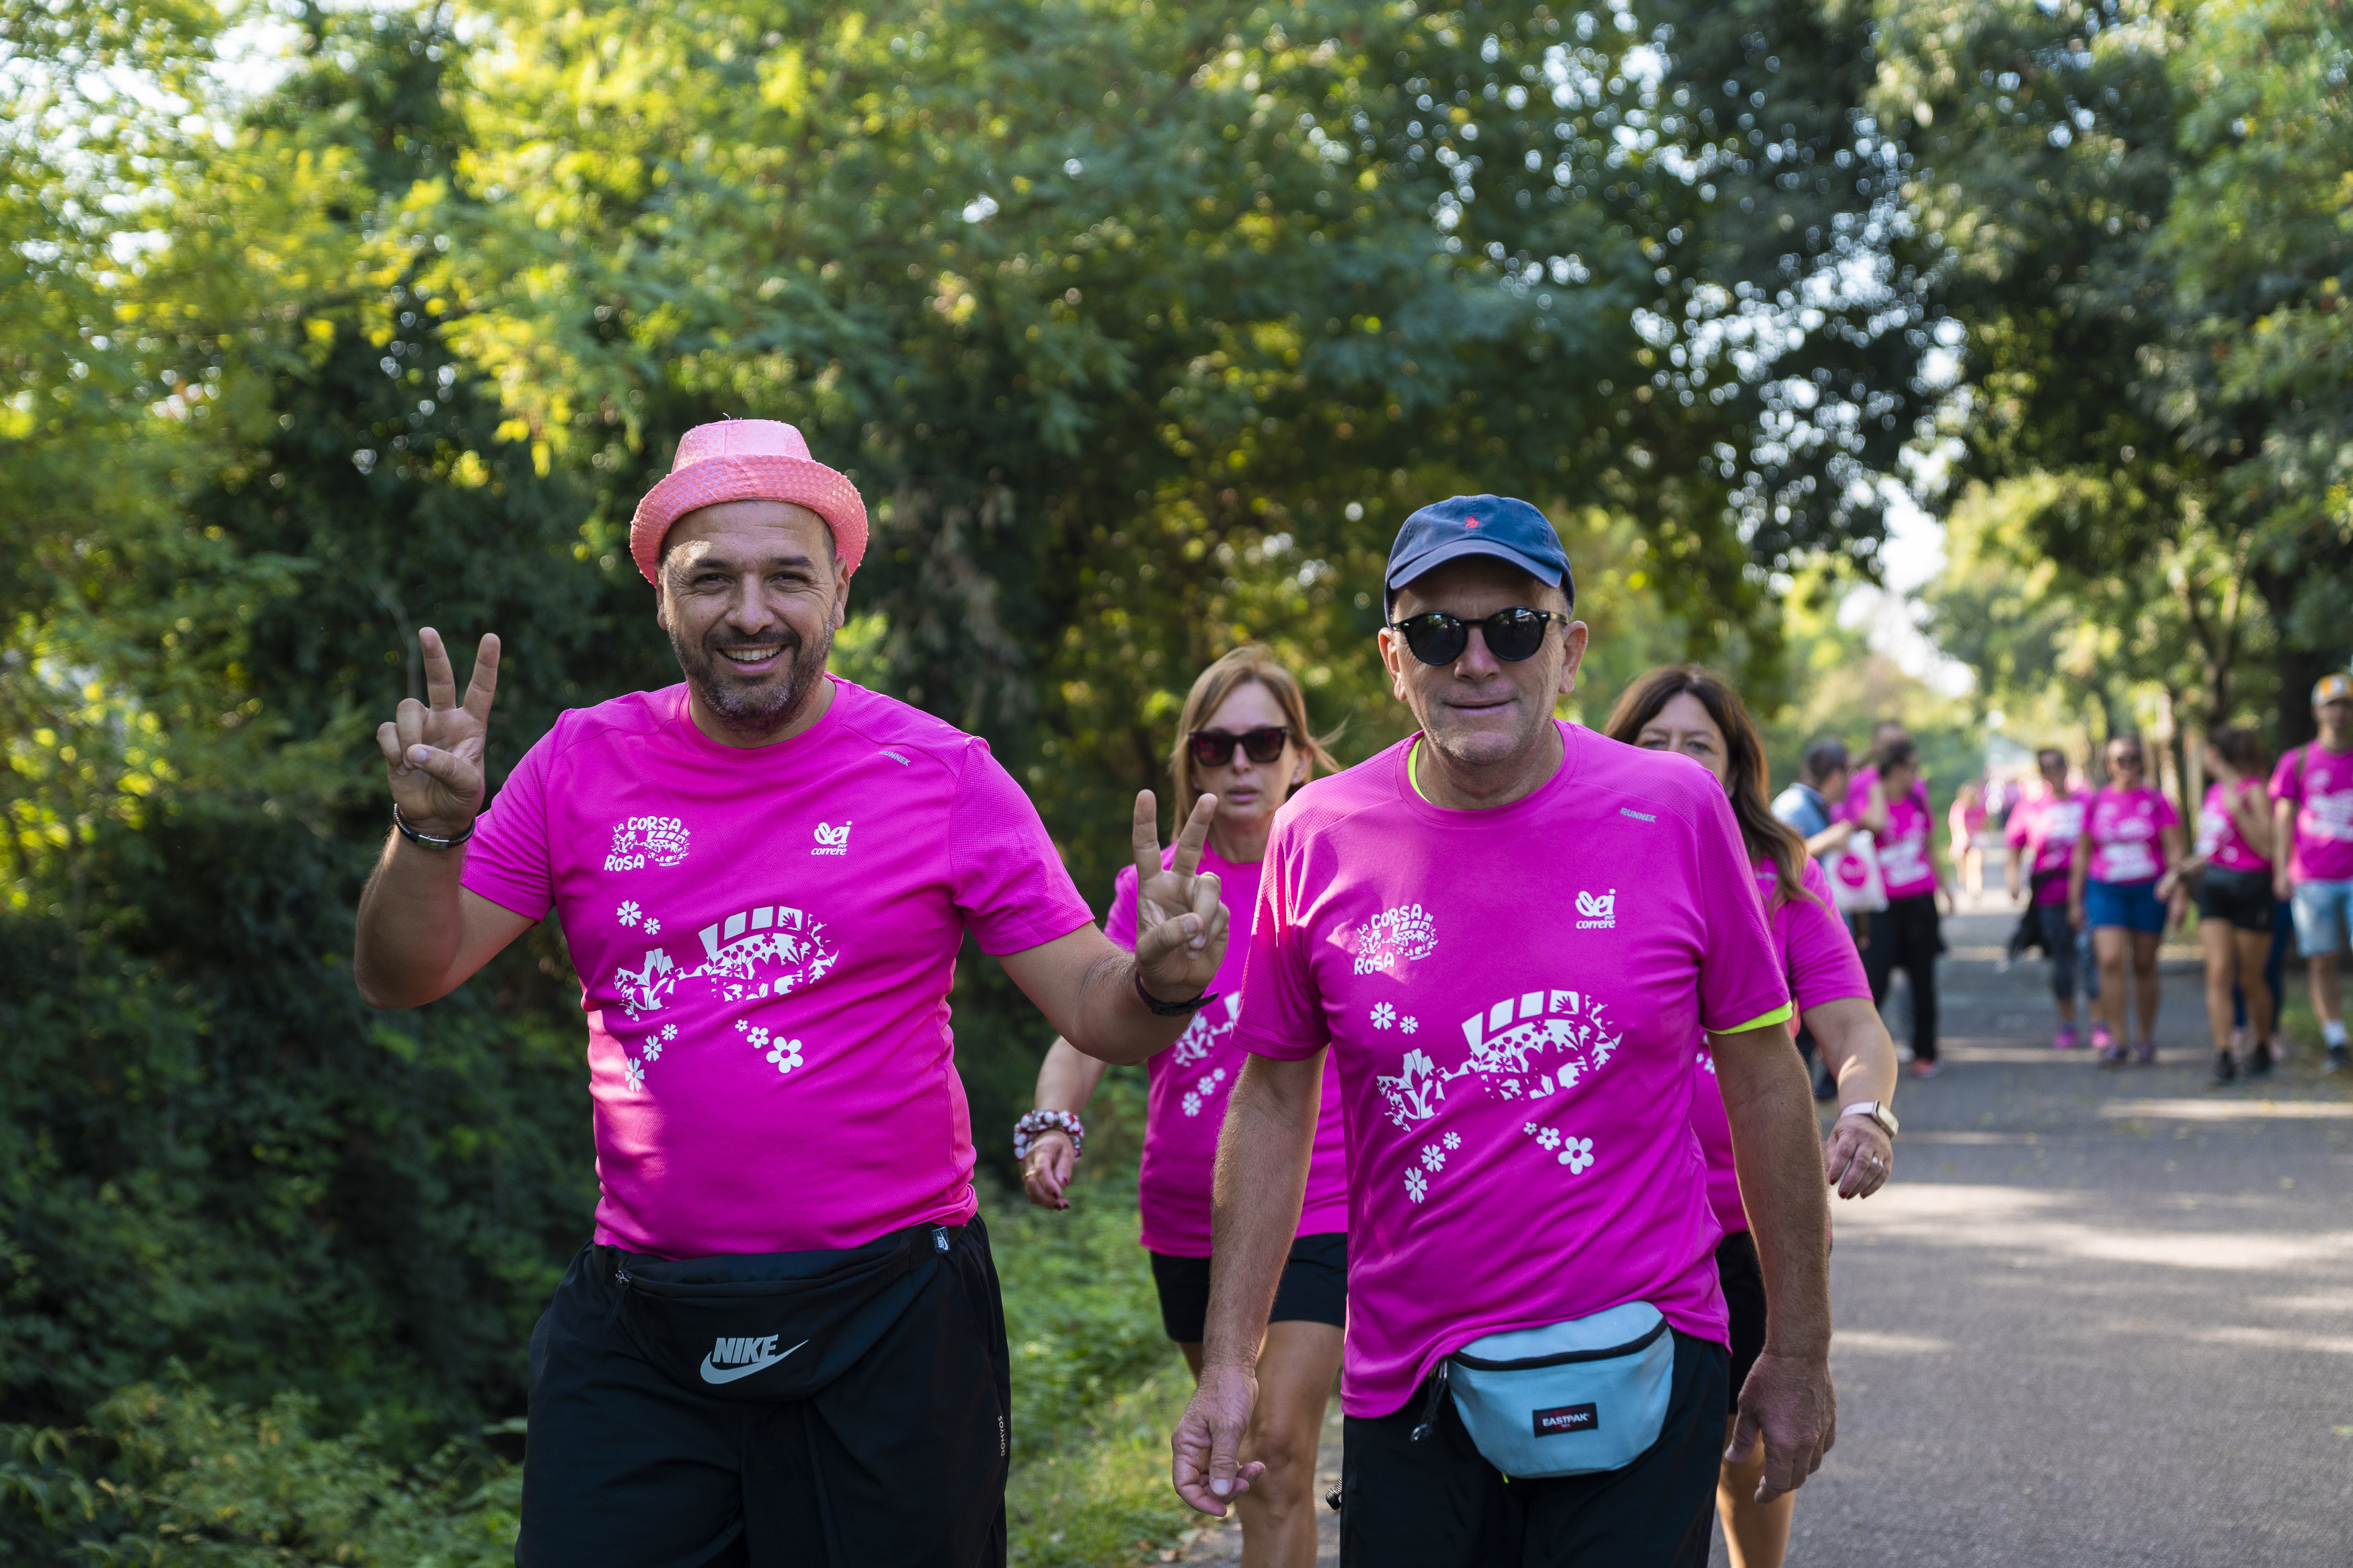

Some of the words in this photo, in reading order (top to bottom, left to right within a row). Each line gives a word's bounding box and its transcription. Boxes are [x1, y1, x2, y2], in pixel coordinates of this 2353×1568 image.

[1620, 807, 1657, 823] RUNNEK
[612, 823, 625, 833] LA
[627, 815, 682, 833] CORSA
[680, 827, 690, 837] IN
[813, 820, 852, 845] Sei
[811, 848, 847, 856] correre
[604, 854, 645, 872] ROSA
[1574, 888, 1616, 917] Sei
[1357, 923, 1369, 935] LA
[1371, 903, 1423, 930] CORSA
[1423, 912, 1434, 922] IN
[1575, 919, 1616, 930] correre
[1354, 952, 1395, 975] ROSA
[936, 1236, 945, 1248] NIKE
[712, 1334, 779, 1364] NIKE
[1542, 1412, 1589, 1427] EASTPAK
